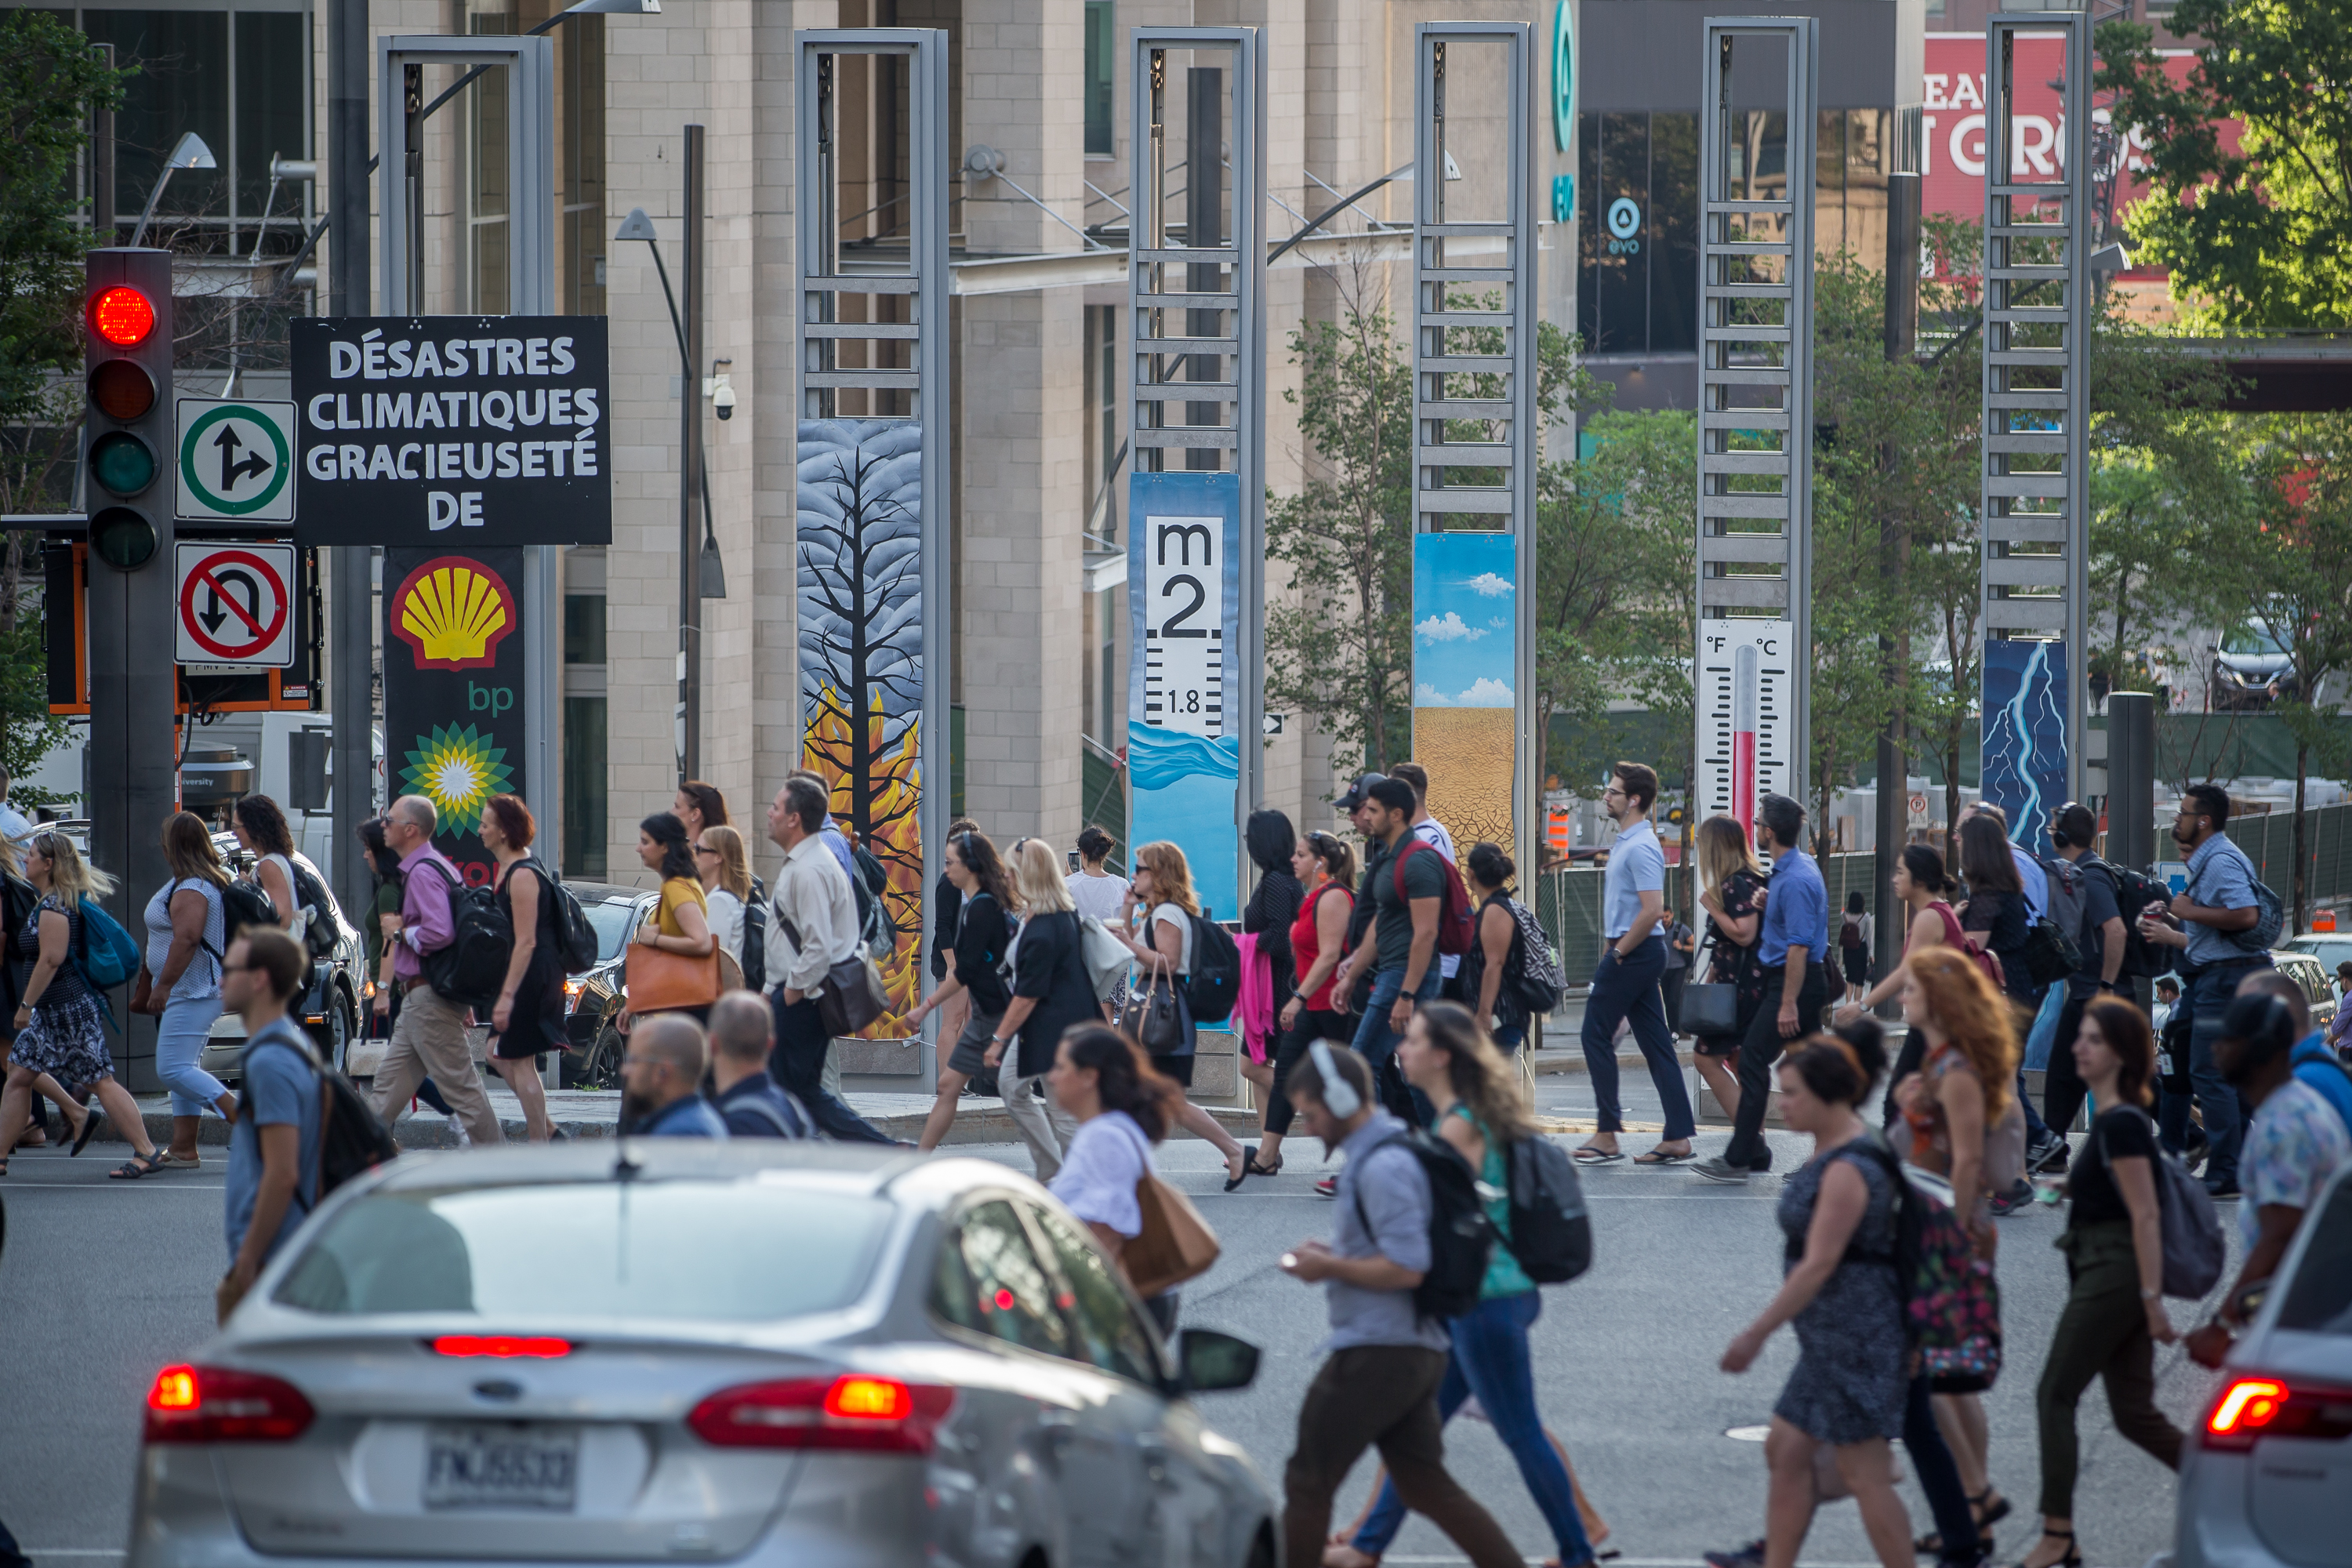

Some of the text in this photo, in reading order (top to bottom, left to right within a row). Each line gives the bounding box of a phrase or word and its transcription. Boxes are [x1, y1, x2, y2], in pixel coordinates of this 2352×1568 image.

[1608, 238, 1640, 256] evo
[330, 328, 575, 379] DÉSASTRES
[308, 388, 600, 431] CLIMATIQUES
[307, 426, 598, 481] GRACIEUSETÉ
[428, 491, 485, 531] DE
[1157, 523, 1212, 566] m
[1161, 574, 1208, 639] 2
[1706, 636, 1726, 654] °F
[1756, 638, 1777, 656] °C
[468, 680, 514, 718] bp
[1168, 689, 1200, 714] 1.8
[181, 777, 214, 786] iversity
